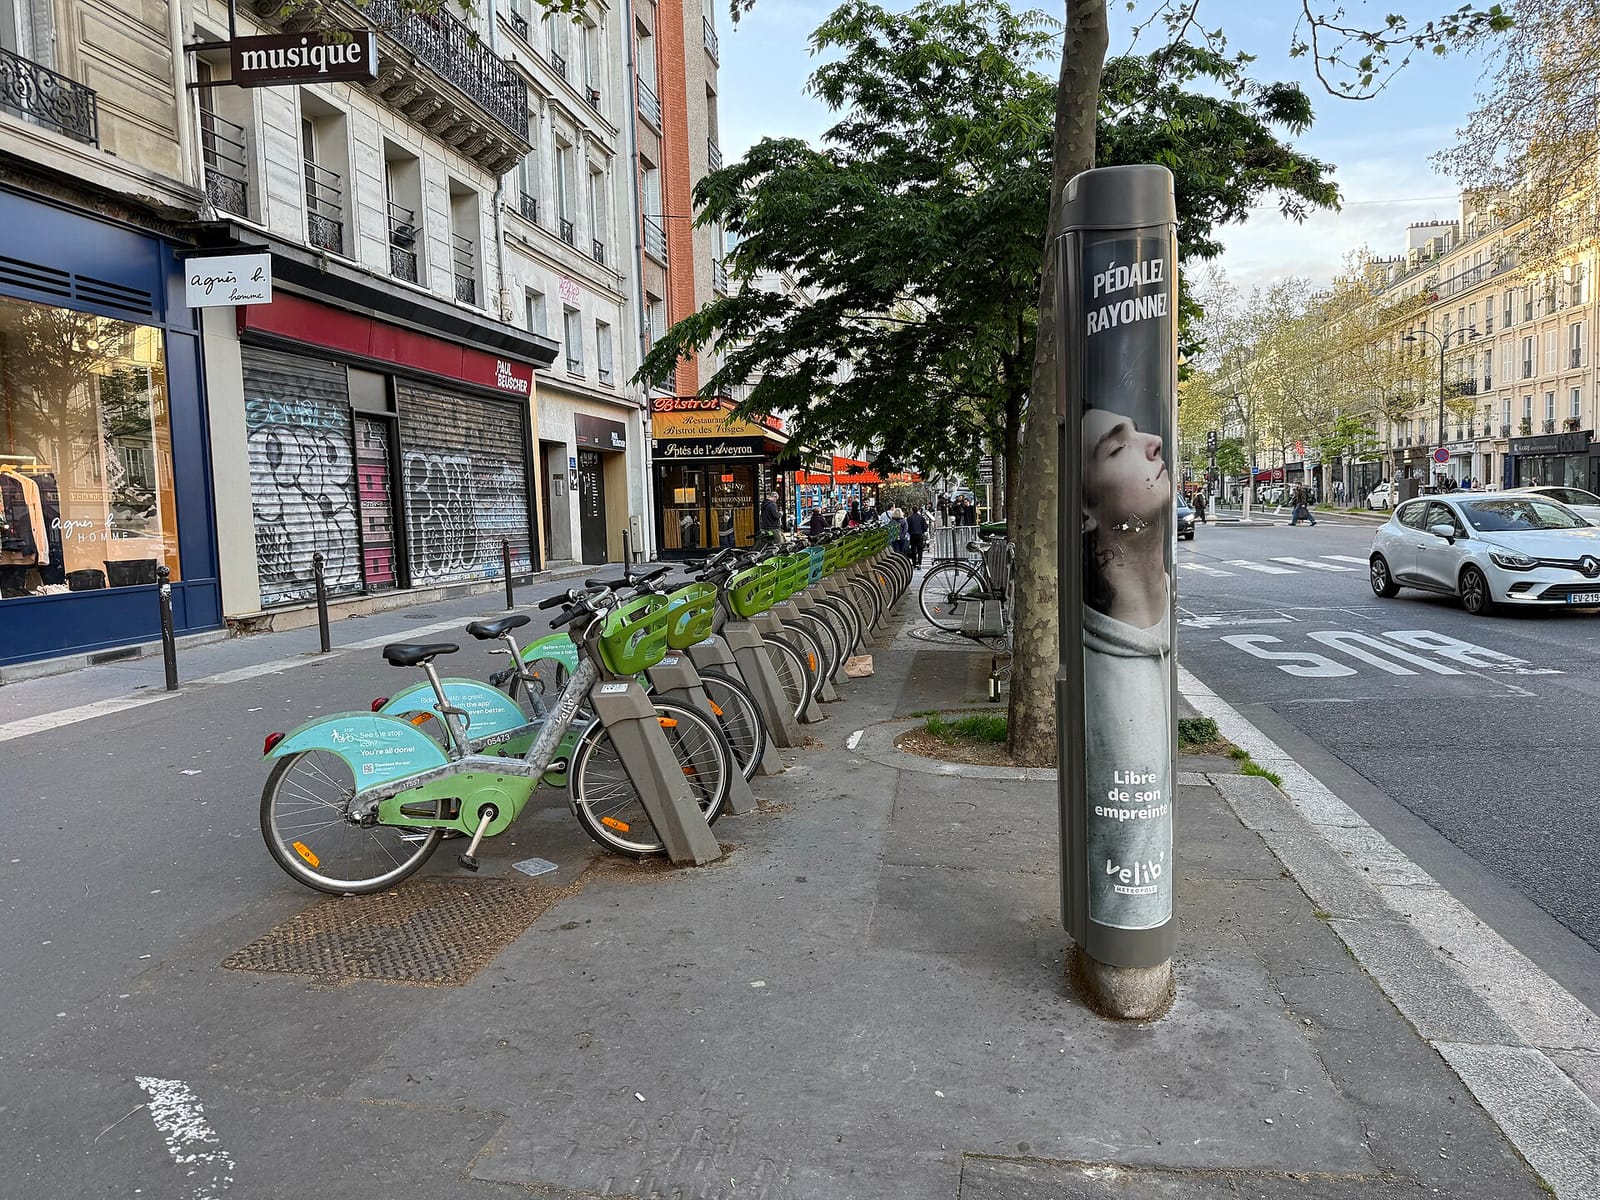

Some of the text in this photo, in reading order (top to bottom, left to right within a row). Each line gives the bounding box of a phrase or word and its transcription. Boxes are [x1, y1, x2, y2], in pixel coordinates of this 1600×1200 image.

[240, 37, 362, 72] musique
[191, 270, 237, 295] agnès
[1093, 258, 1164, 299] PÉDALEZ
[228, 287, 265, 301] homme
[1087, 292, 1168, 337] RAYONNEZ
[495, 360, 512, 376] PAUL
[497, 373, 528, 393] BEUSCHER
[653, 397, 719, 412] Bistrot
[663, 425, 695, 435] Bistrot
[698, 425, 712, 434] des
[693, 445, 704, 455] de
[78, 531, 129, 542] HOMME
[1220, 629, 1567, 678] BUS
[360, 731, 374, 739] See
[387, 729, 403, 738] stop
[486, 733, 511, 746] 05473
[360, 748, 384, 756] You're
[394, 745, 415, 754] done!
[1113, 770, 1157, 785] Libre
[1107, 788, 1161, 802] de son
[1094, 803, 1168, 822] empreinte
